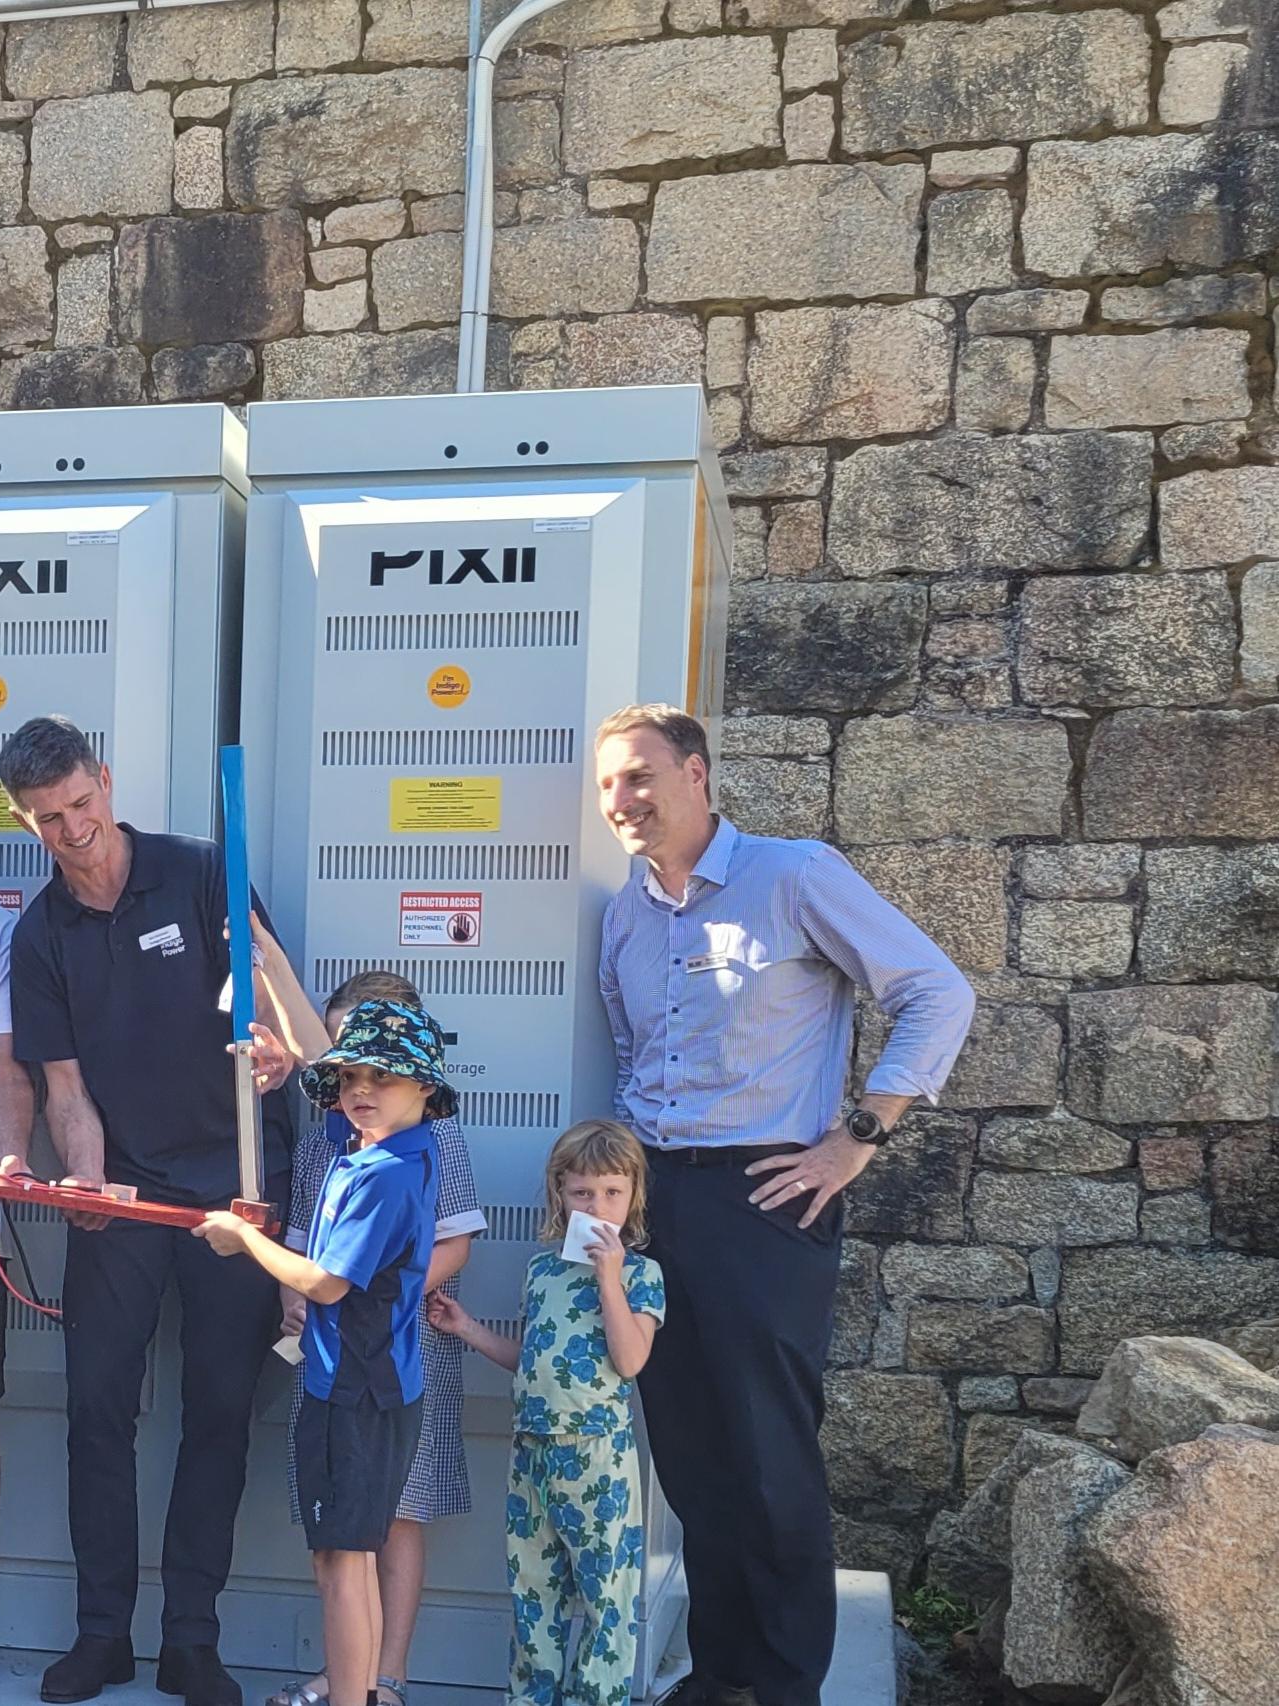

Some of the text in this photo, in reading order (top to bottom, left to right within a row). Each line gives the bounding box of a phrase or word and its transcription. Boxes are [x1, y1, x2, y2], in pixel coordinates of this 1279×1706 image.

[370, 547, 536, 586] PIXII
[402, 896, 480, 908] RESTRICTED ACCESS
[162, 945, 186, 957] Power
[443, 1061, 486, 1078] torage
